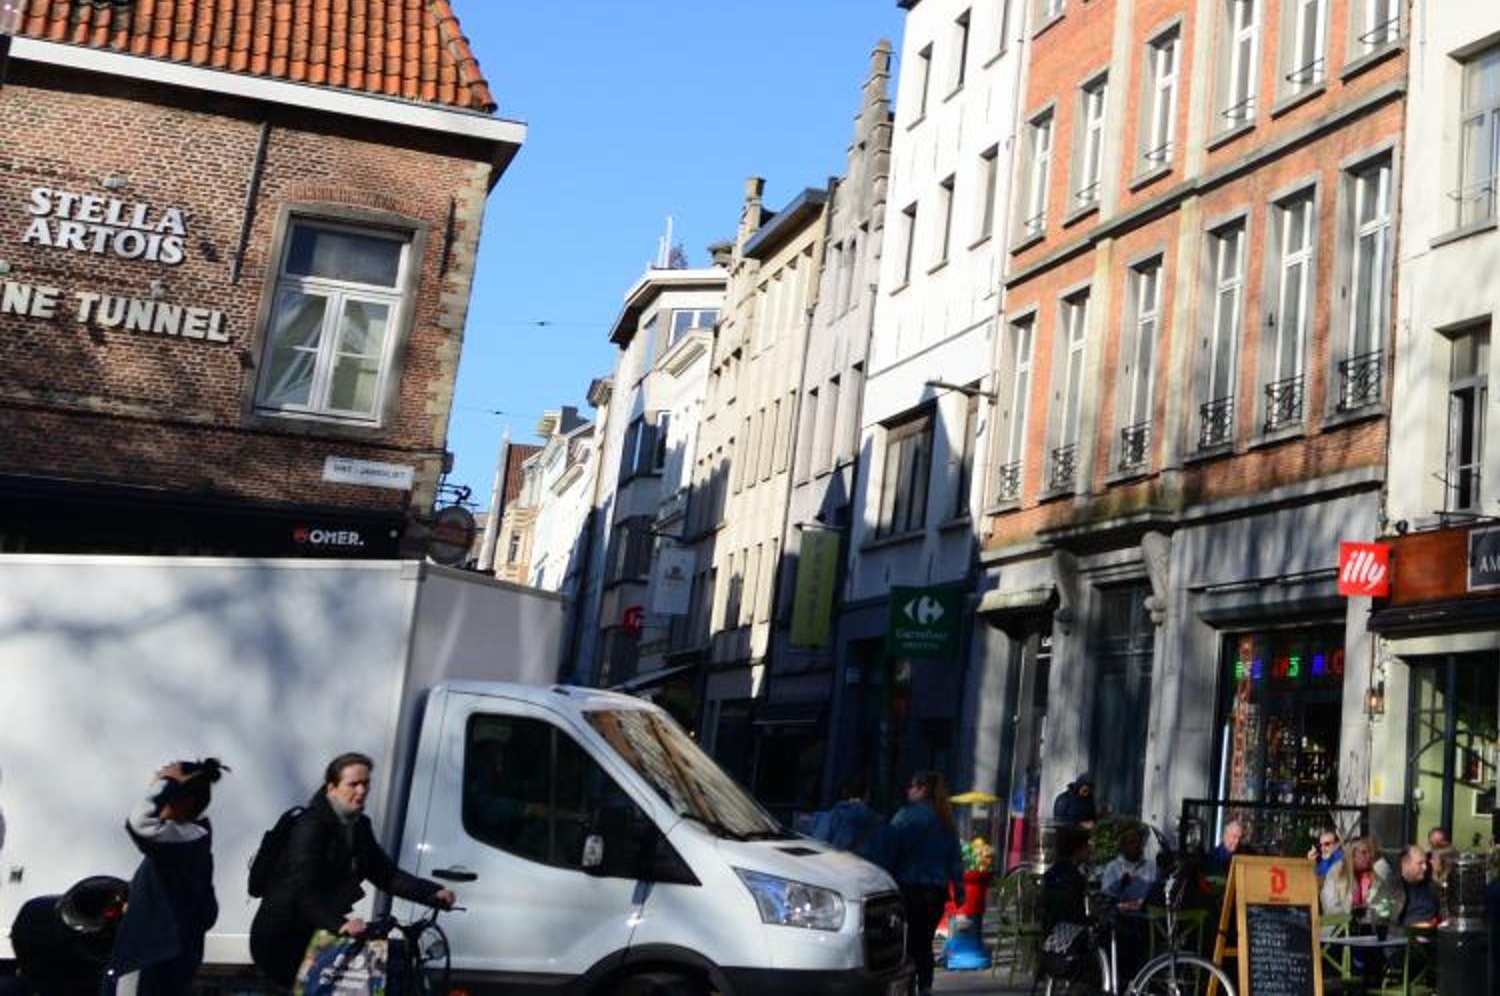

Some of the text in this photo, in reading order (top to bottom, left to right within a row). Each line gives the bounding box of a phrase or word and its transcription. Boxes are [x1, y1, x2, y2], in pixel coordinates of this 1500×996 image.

[30, 188, 186, 235] STELLA
[22, 217, 183, 264] ARTOIS
[75, 290, 229, 342] TUNNEL
[1343, 550, 1386, 590] illy
